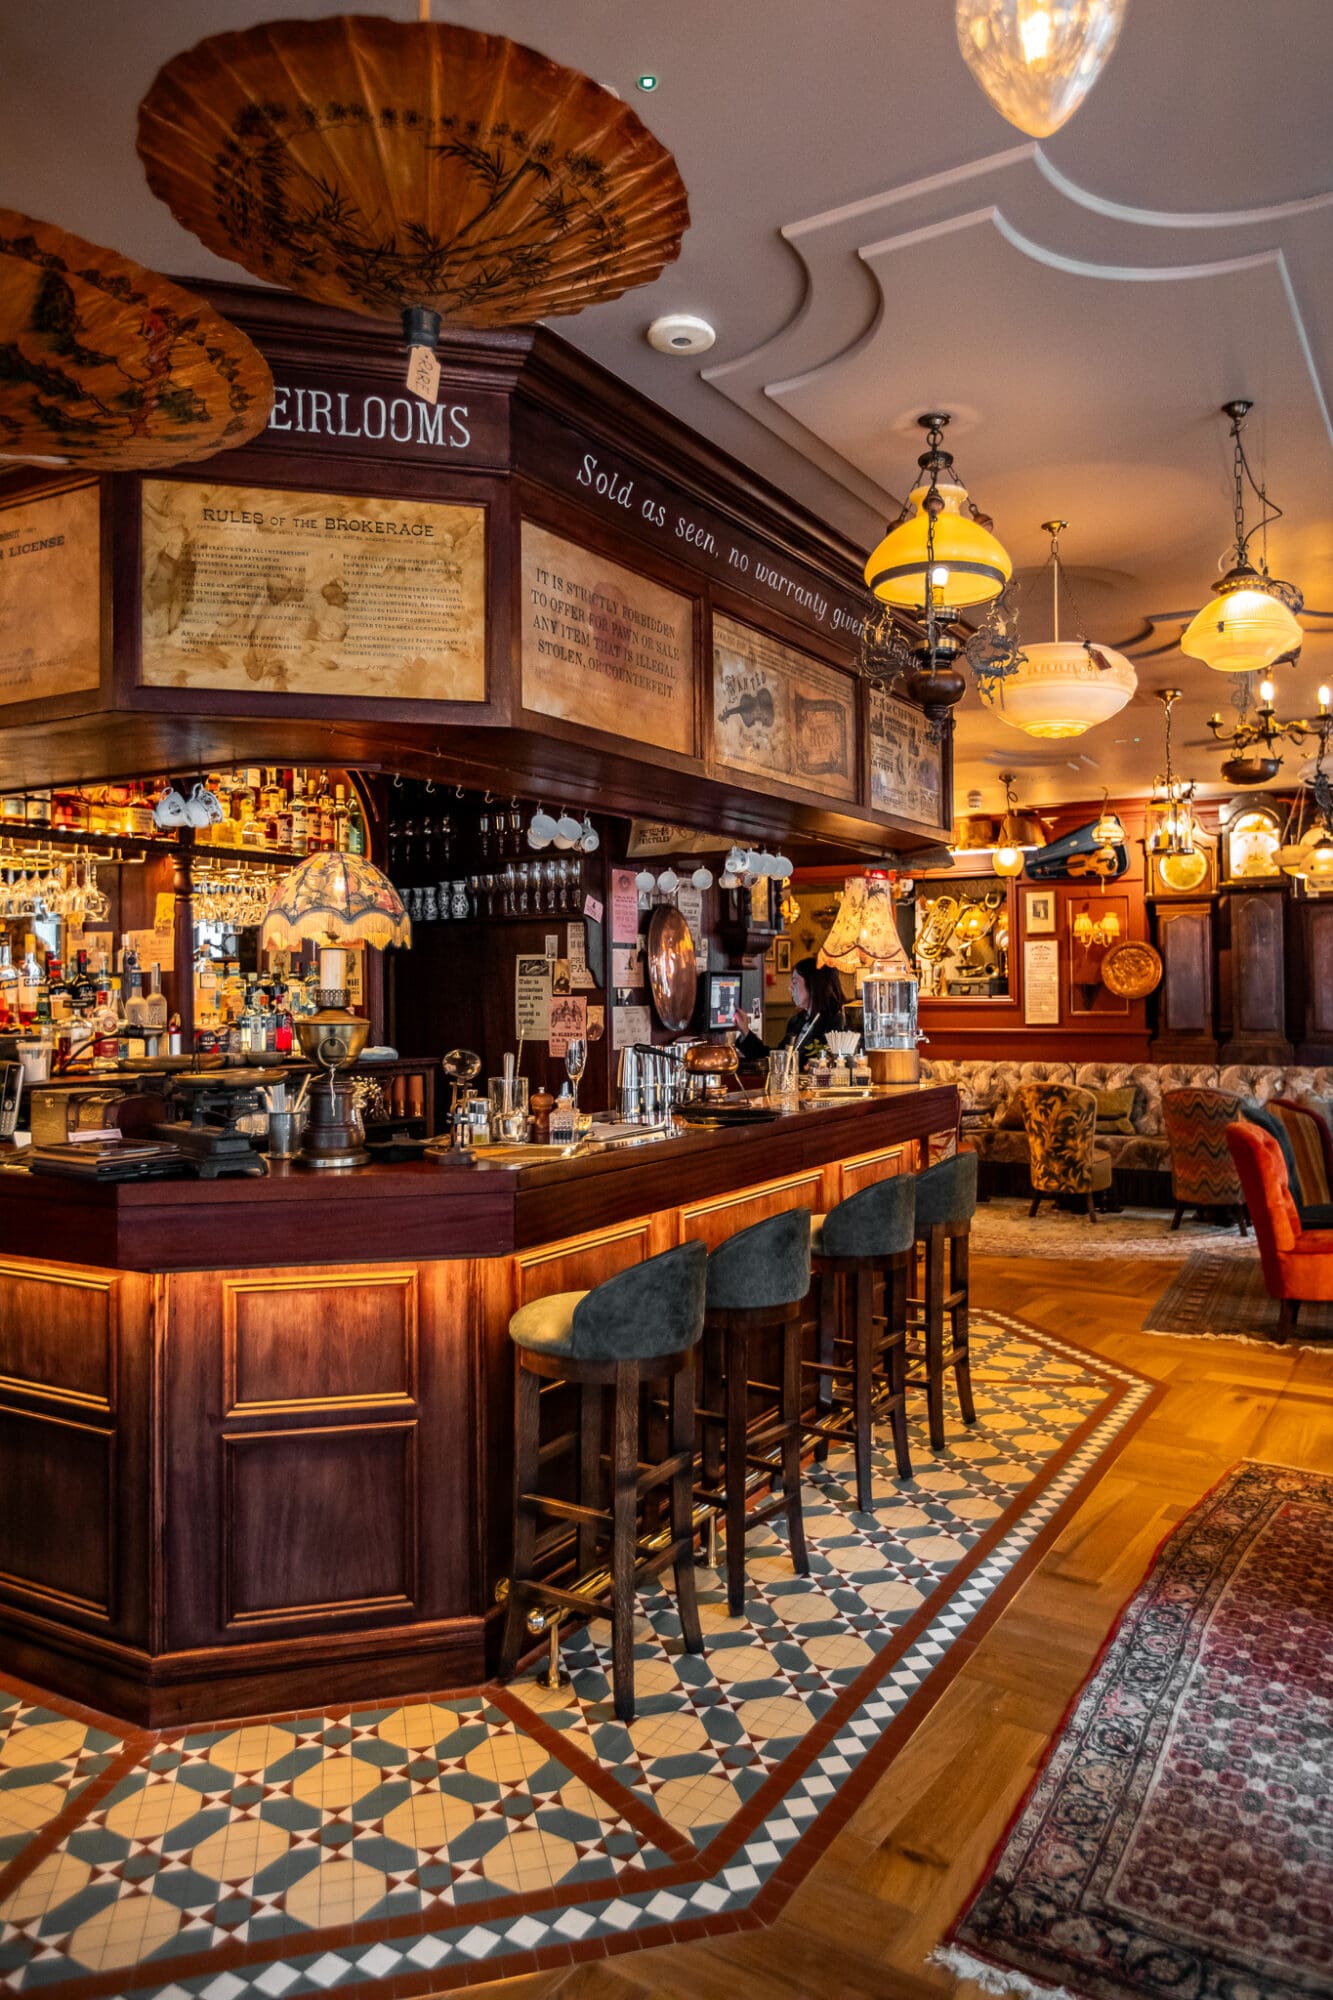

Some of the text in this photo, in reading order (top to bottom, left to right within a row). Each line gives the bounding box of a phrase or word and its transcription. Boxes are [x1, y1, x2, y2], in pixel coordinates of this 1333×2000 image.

[416, 360, 433, 395] RARE
[9, 535, 65, 558] LICENSE
[202, 508, 264, 524] RULES
[270, 516, 286, 526] OF
[293, 518, 318, 528] THE
[324, 518, 435, 537] BROKERAGE
[576, 454, 865, 637] Sold as seen, no warranty given
[531, 589, 680, 661] TO OFFER FOR PAWN OR SALE
[536, 568, 676, 639] IT IS STRICTLY FORBIDDEN
[533, 614, 558, 634] ANY
[561, 624, 590, 648] ITEM
[594, 637, 621, 658] THAT
[624, 648, 634, 662] IS
[538, 638, 675, 699] STOLEN, OR COUNTERFEIT.
